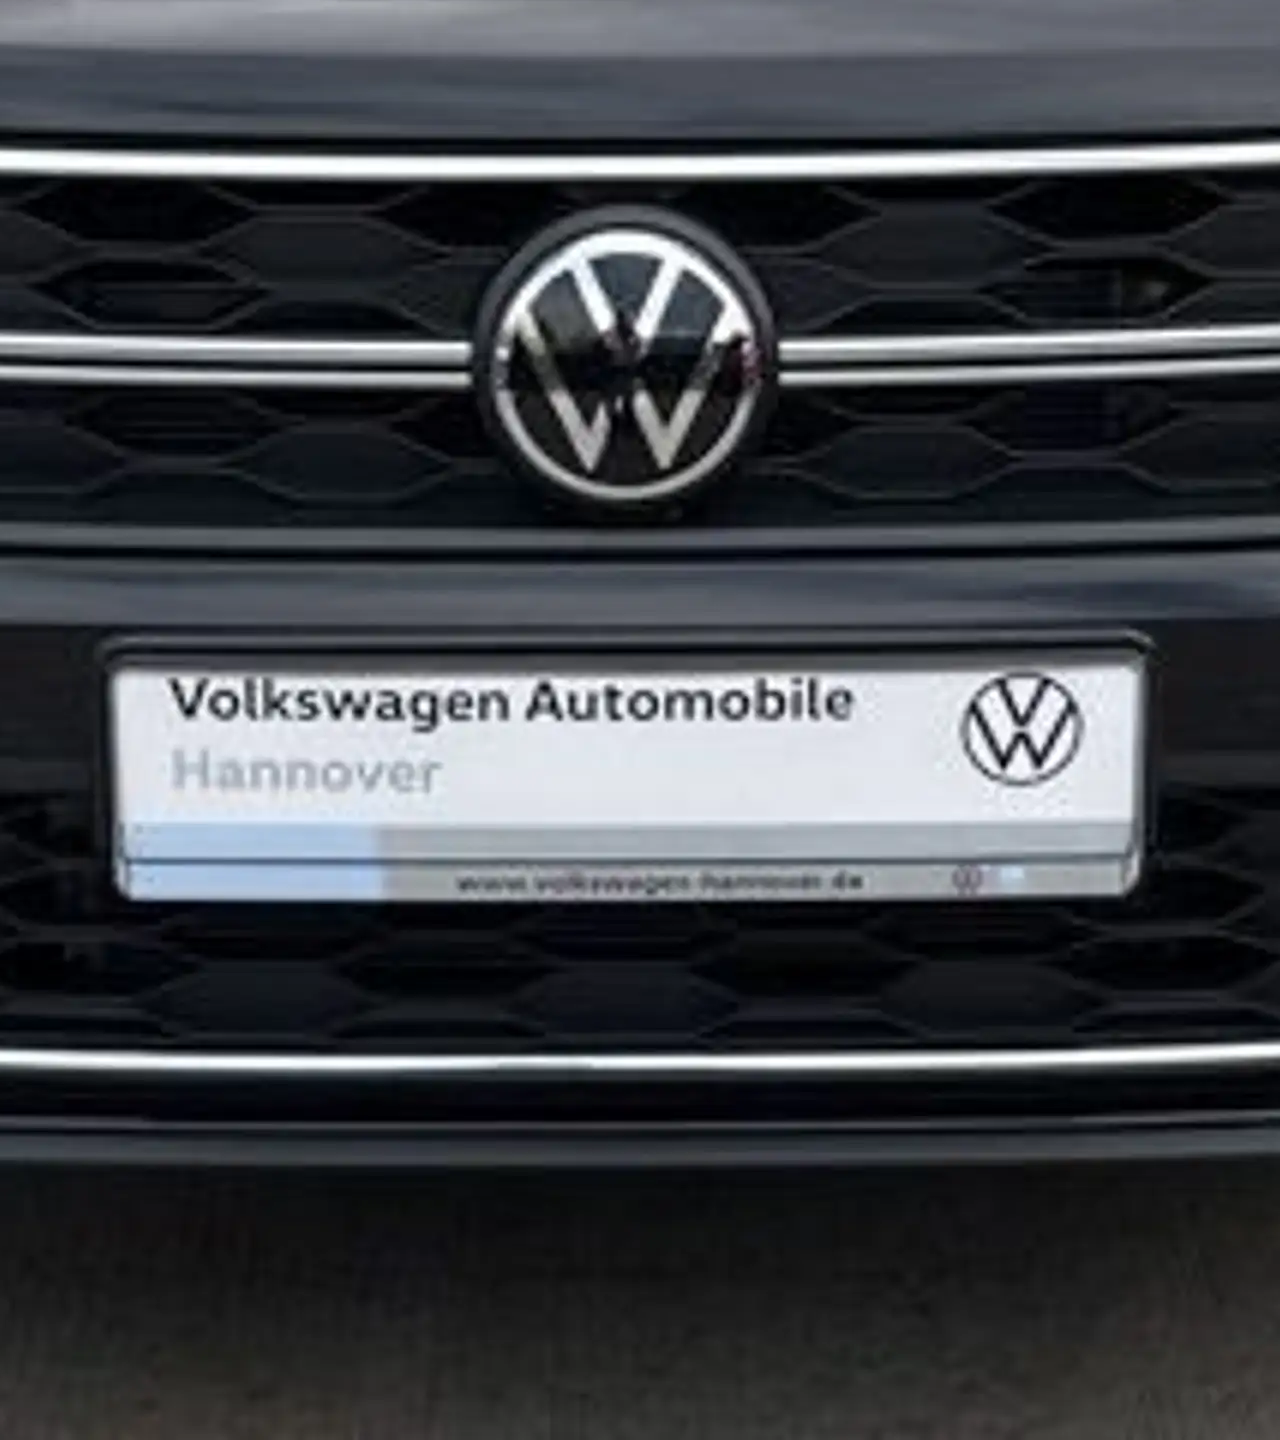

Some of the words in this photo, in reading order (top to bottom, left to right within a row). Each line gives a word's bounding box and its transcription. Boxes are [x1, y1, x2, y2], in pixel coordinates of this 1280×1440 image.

[168, 675, 512, 734] Volkswagen
[524, 676, 856, 722] Automobile
[172, 748, 443, 792] Hannover
